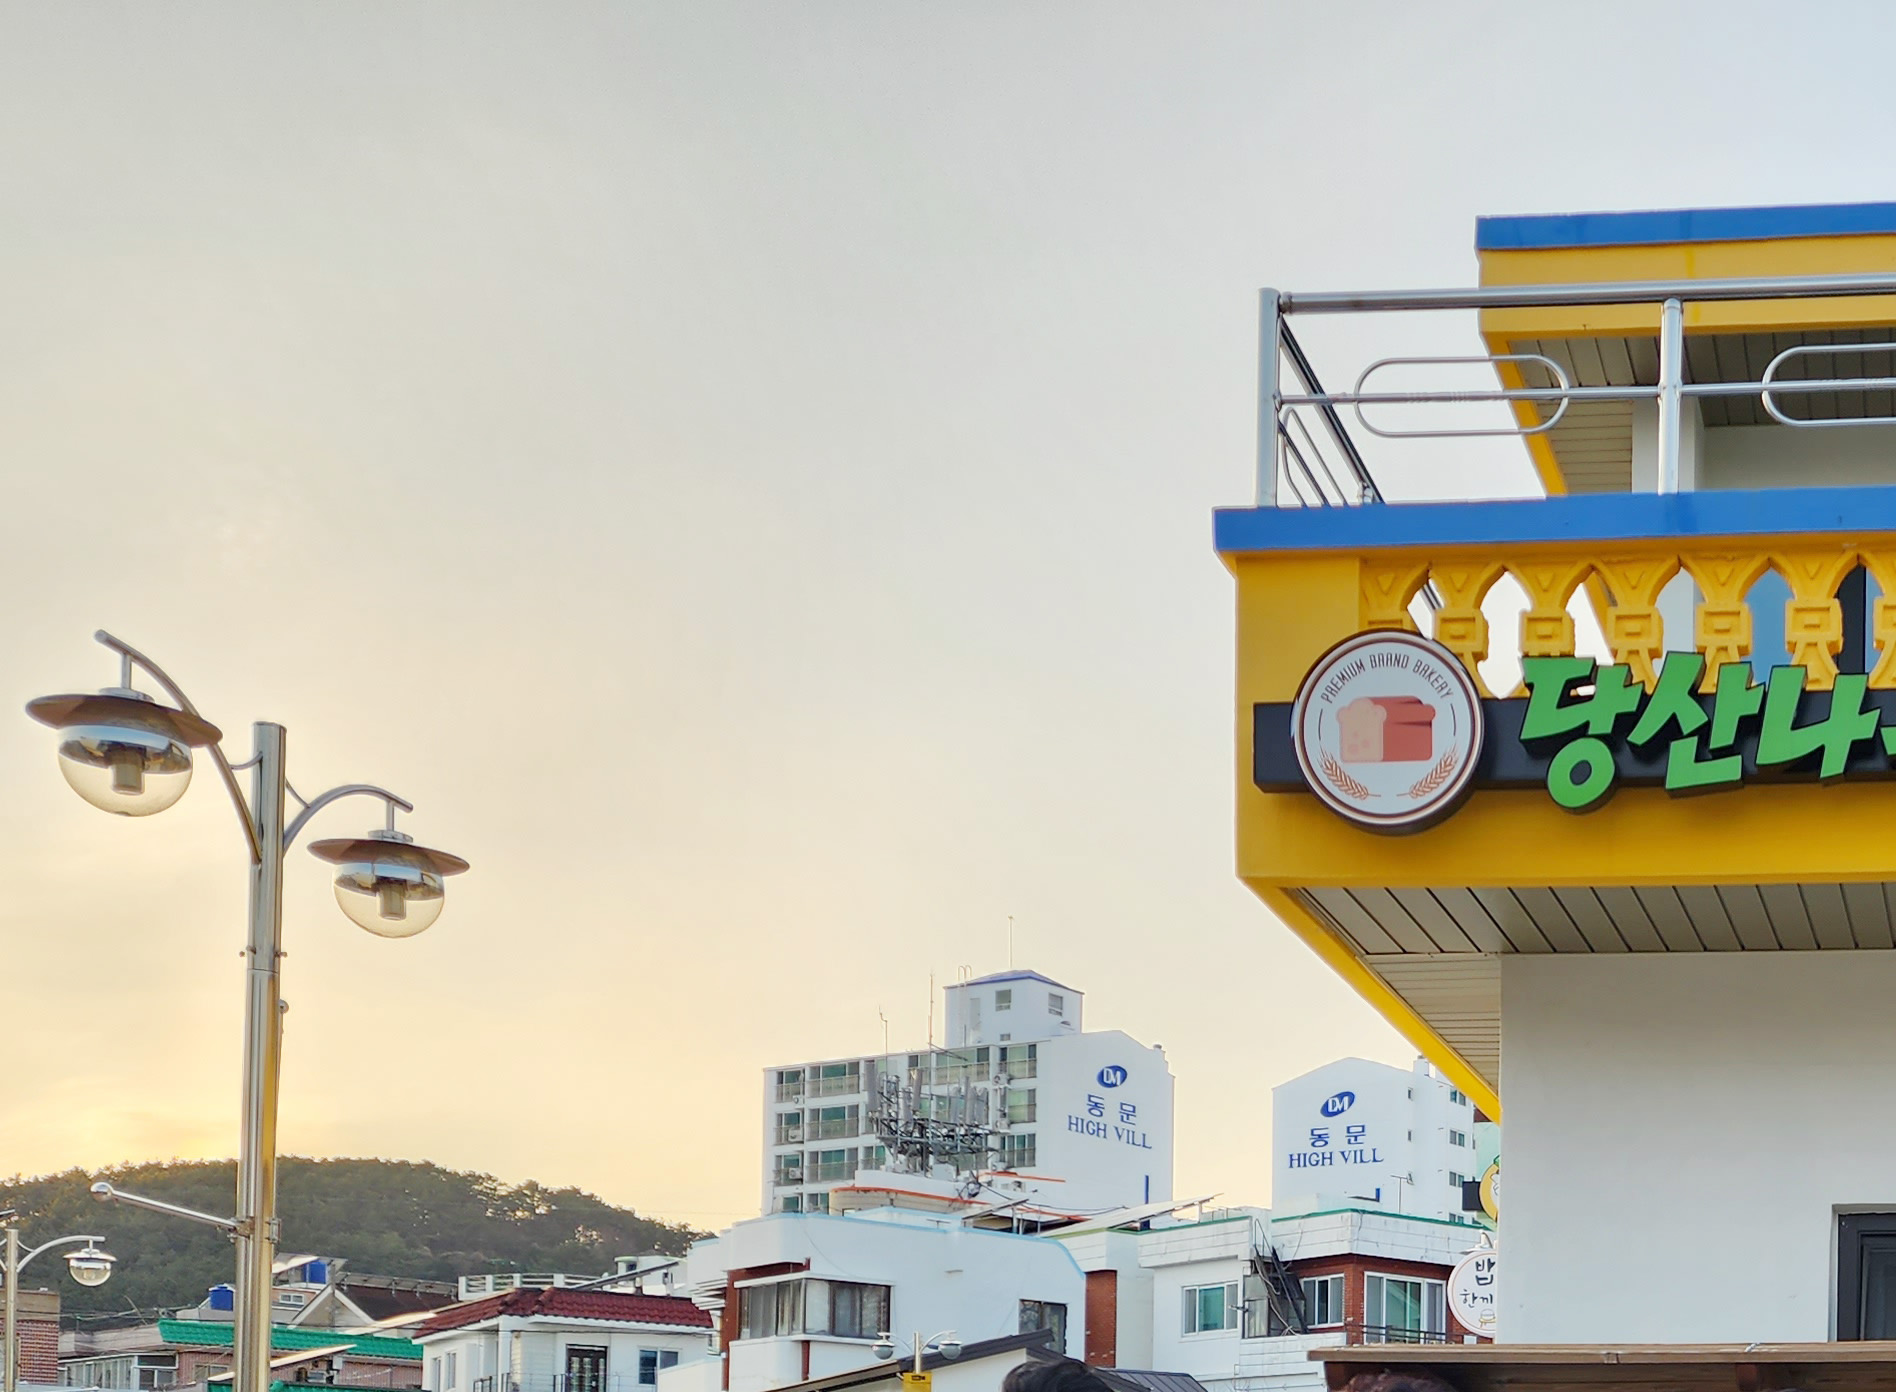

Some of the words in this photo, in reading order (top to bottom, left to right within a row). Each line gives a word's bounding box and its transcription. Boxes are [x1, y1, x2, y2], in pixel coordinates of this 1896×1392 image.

[1321, 659, 1365, 703] PREMIUM
[1369, 652, 1410, 670] BRAND
[1412, 658, 1454, 700] BAKERY
[1086, 1094, 1137, 1126] 동문
[1067, 1115, 1107, 1139] HIGH
[1113, 1125, 1152, 1149] VILL
[1309, 1124, 1366, 1148] 동문
[1288, 1151, 1334, 1169] HIGH
[1339, 1148, 1385, 1164] VILL
[1459, 1288, 1493, 1309] 한끼
